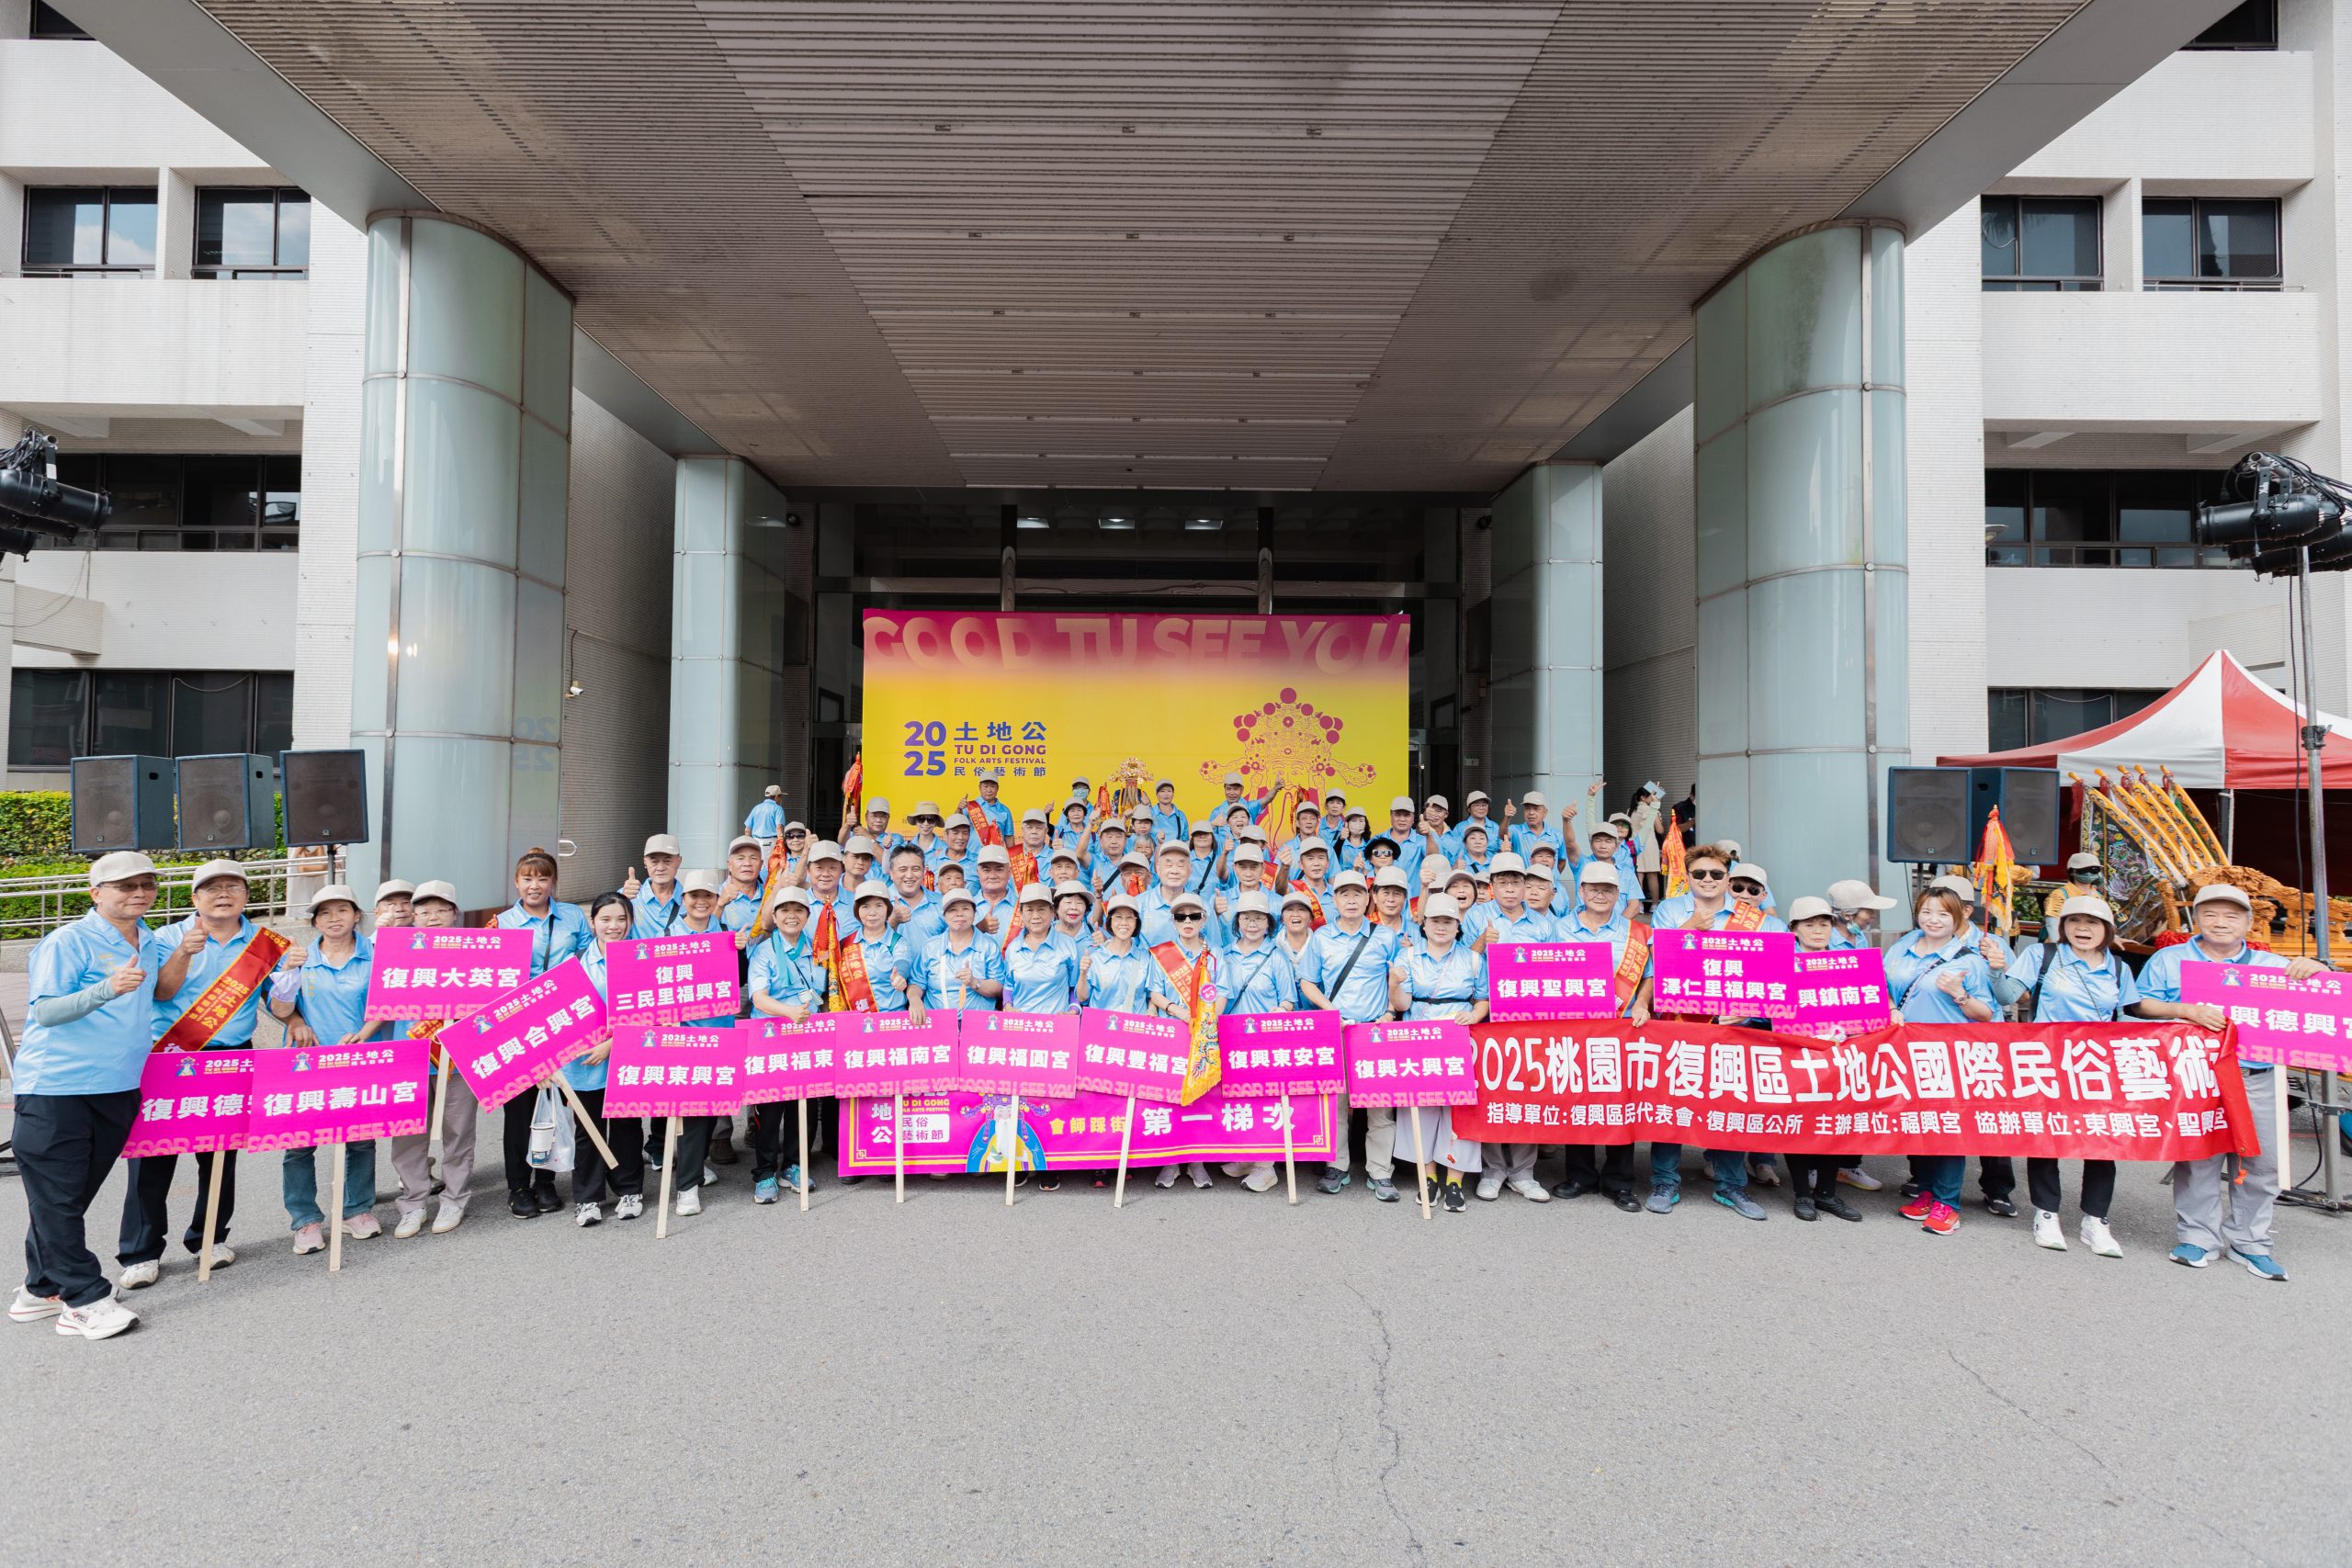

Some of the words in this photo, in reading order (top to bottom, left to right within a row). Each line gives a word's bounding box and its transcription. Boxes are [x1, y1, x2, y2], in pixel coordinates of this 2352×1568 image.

[864, 616, 1038, 670] GOOD
[1057, 618, 1138, 669] TU
[1154, 618, 1265, 671] SEE
[1279, 620, 1411, 675] YOU
[904, 721, 946, 747] 20
[954, 721, 1046, 741] 土地公
[955, 745, 974, 755] TU
[980, 745, 996, 755] DI
[1001, 744, 1046, 755] GONG
[904, 750, 946, 776] 25
[954, 766, 1046, 777] 民俗藝術節
[434, 936, 502, 944] 2025土地公
[382, 967, 521, 988] 復興大英宮
[656, 964, 694, 985] 復興
[1702, 958, 1744, 977] 復興
[223, 976, 250, 996] 2025
[616, 981, 732, 1011] 三民里福興宮
[1498, 978, 1606, 998] 復興聖興宮
[1662, 978, 1787, 1001] 澤仁里福興宮
[201, 994, 237, 1030] 土地公
[879, 1017, 933, 1027] 2025土公
[471, 995, 595, 1079] 復興合興宮
[319, 1049, 394, 1062] 2025土地公
[844, 1045, 951, 1069] 復興福南宮
[1085, 1043, 1187, 1076] 復興豐福宮
[1228, 1047, 1335, 1069] 復興東安宮
[617, 1066, 736, 1086] 復興東興宮
[1355, 1056, 1464, 1078] 復興大興宮
[141, 1093, 253, 1122] 復興德
[264, 1081, 418, 1117] 復興壽山宮
[924, 1099, 950, 1107] GONG
[870, 1094, 893, 1144] 地公
[902, 1117, 929, 1128] 民俗
